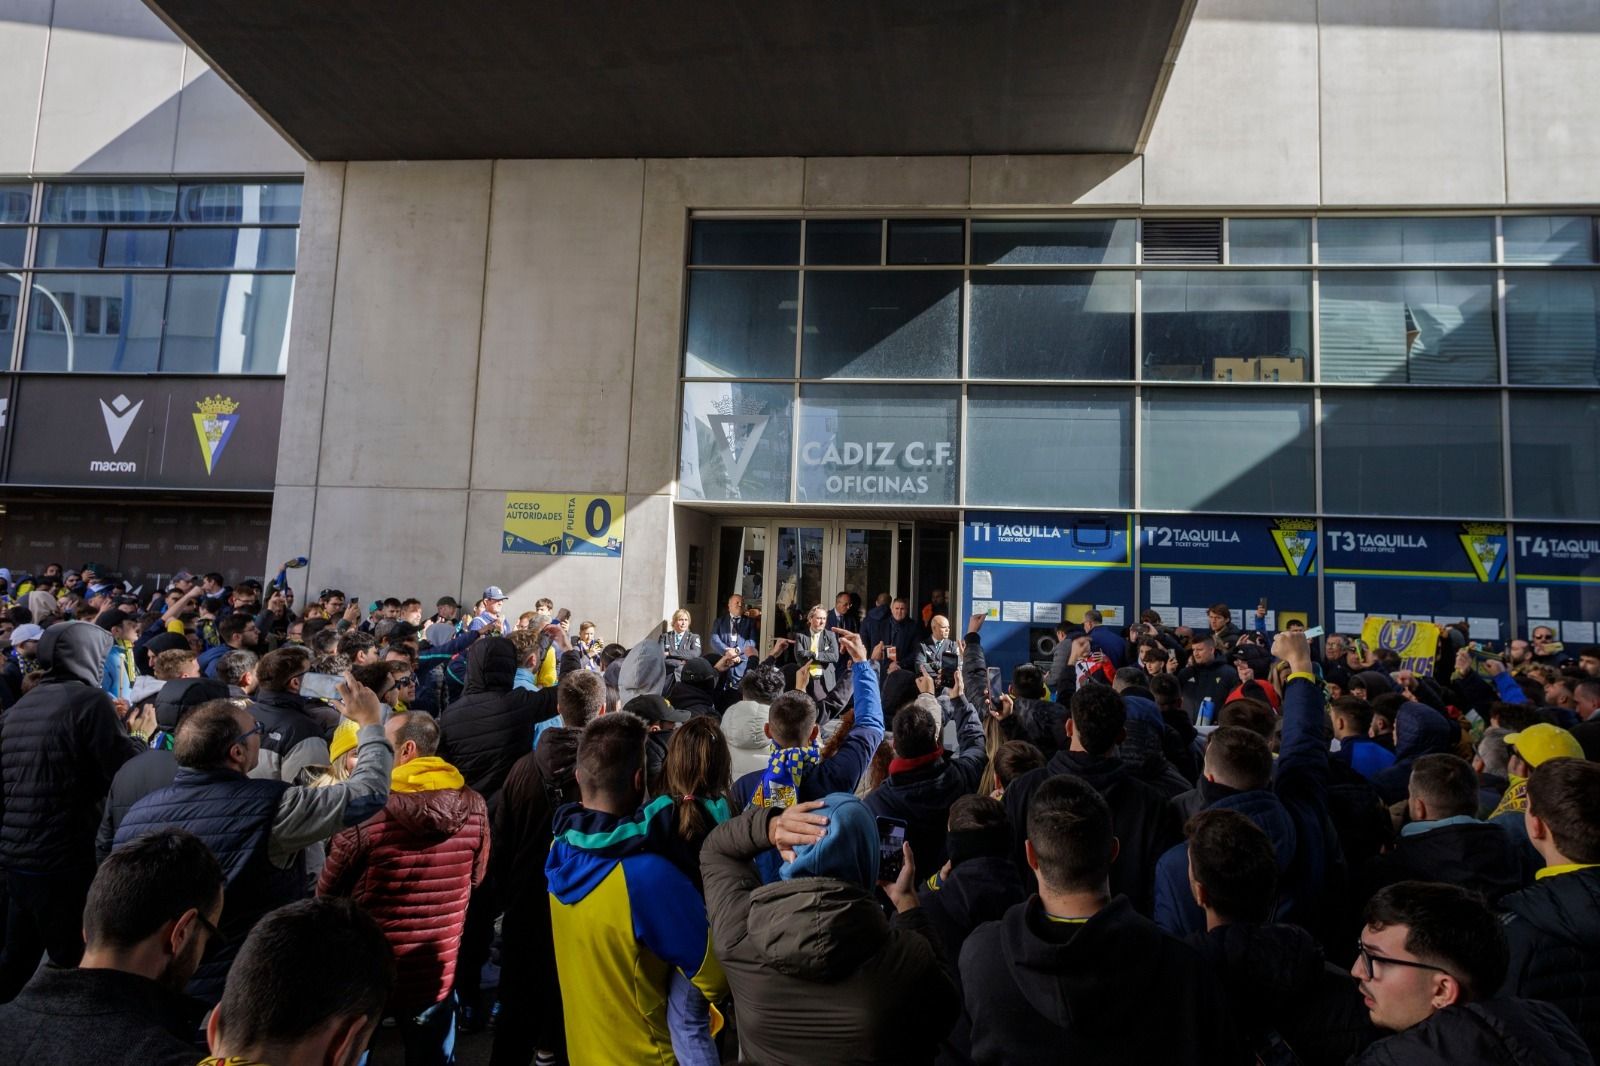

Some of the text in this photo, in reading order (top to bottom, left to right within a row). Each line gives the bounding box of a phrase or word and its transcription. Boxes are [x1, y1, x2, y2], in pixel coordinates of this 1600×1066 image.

[904, 441, 954, 466] C.F.
[90, 460, 137, 473] macron
[825, 475, 929, 494] OFICINAS
[506, 512, 563, 521] AUTORIDADES
[507, 502, 540, 510] ACCESO
[567, 497, 576, 530] PUERTA
[585, 498, 611, 538] 0
[970, 521, 1061, 542] T1 TAQUILLA
[1144, 526, 1240, 547] T2 TAQUILLA
[1327, 530, 1427, 552] T3 TAQUILLA
[1516, 536, 1549, 557] T4
